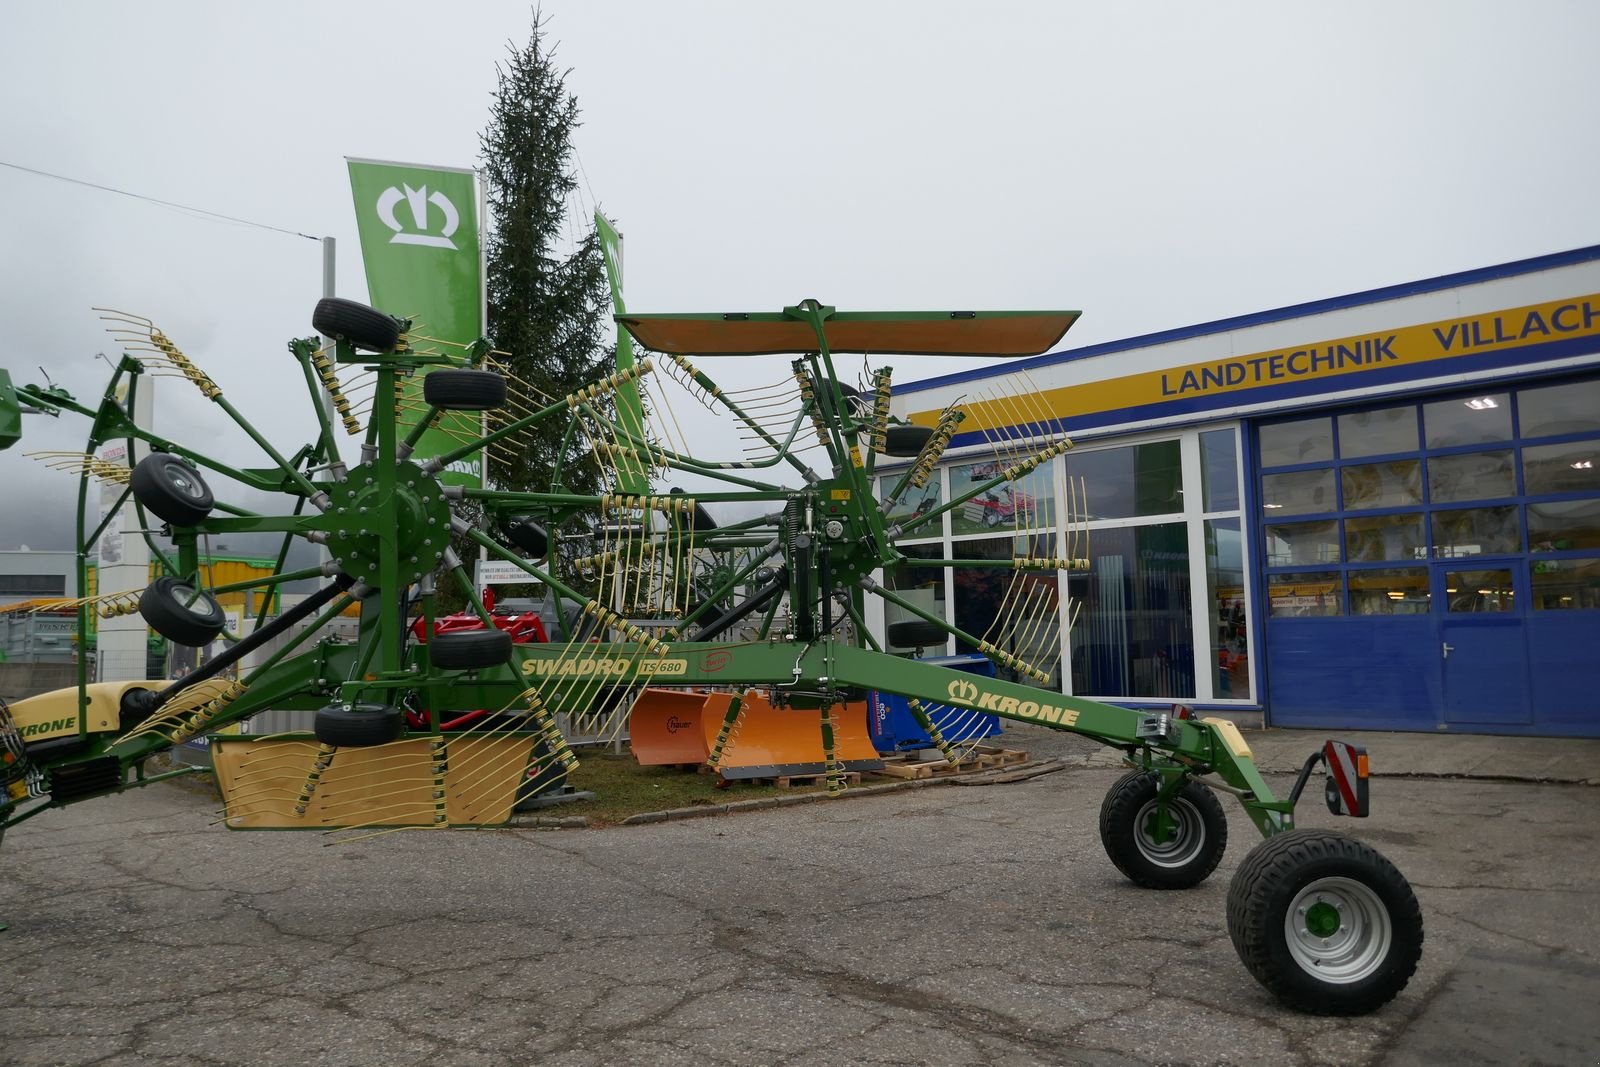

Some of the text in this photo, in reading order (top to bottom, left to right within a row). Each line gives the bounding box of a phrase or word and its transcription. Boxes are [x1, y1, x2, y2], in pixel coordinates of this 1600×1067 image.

[1161, 334, 1399, 396] LANDTECHNIK
[521, 659, 682, 676] SWADRO TS 680
[879, 702, 887, 720] eco
[977, 692, 1080, 727] KRONE
[16, 717, 76, 737] KRONE
[670, 719, 693, 729] hauer
